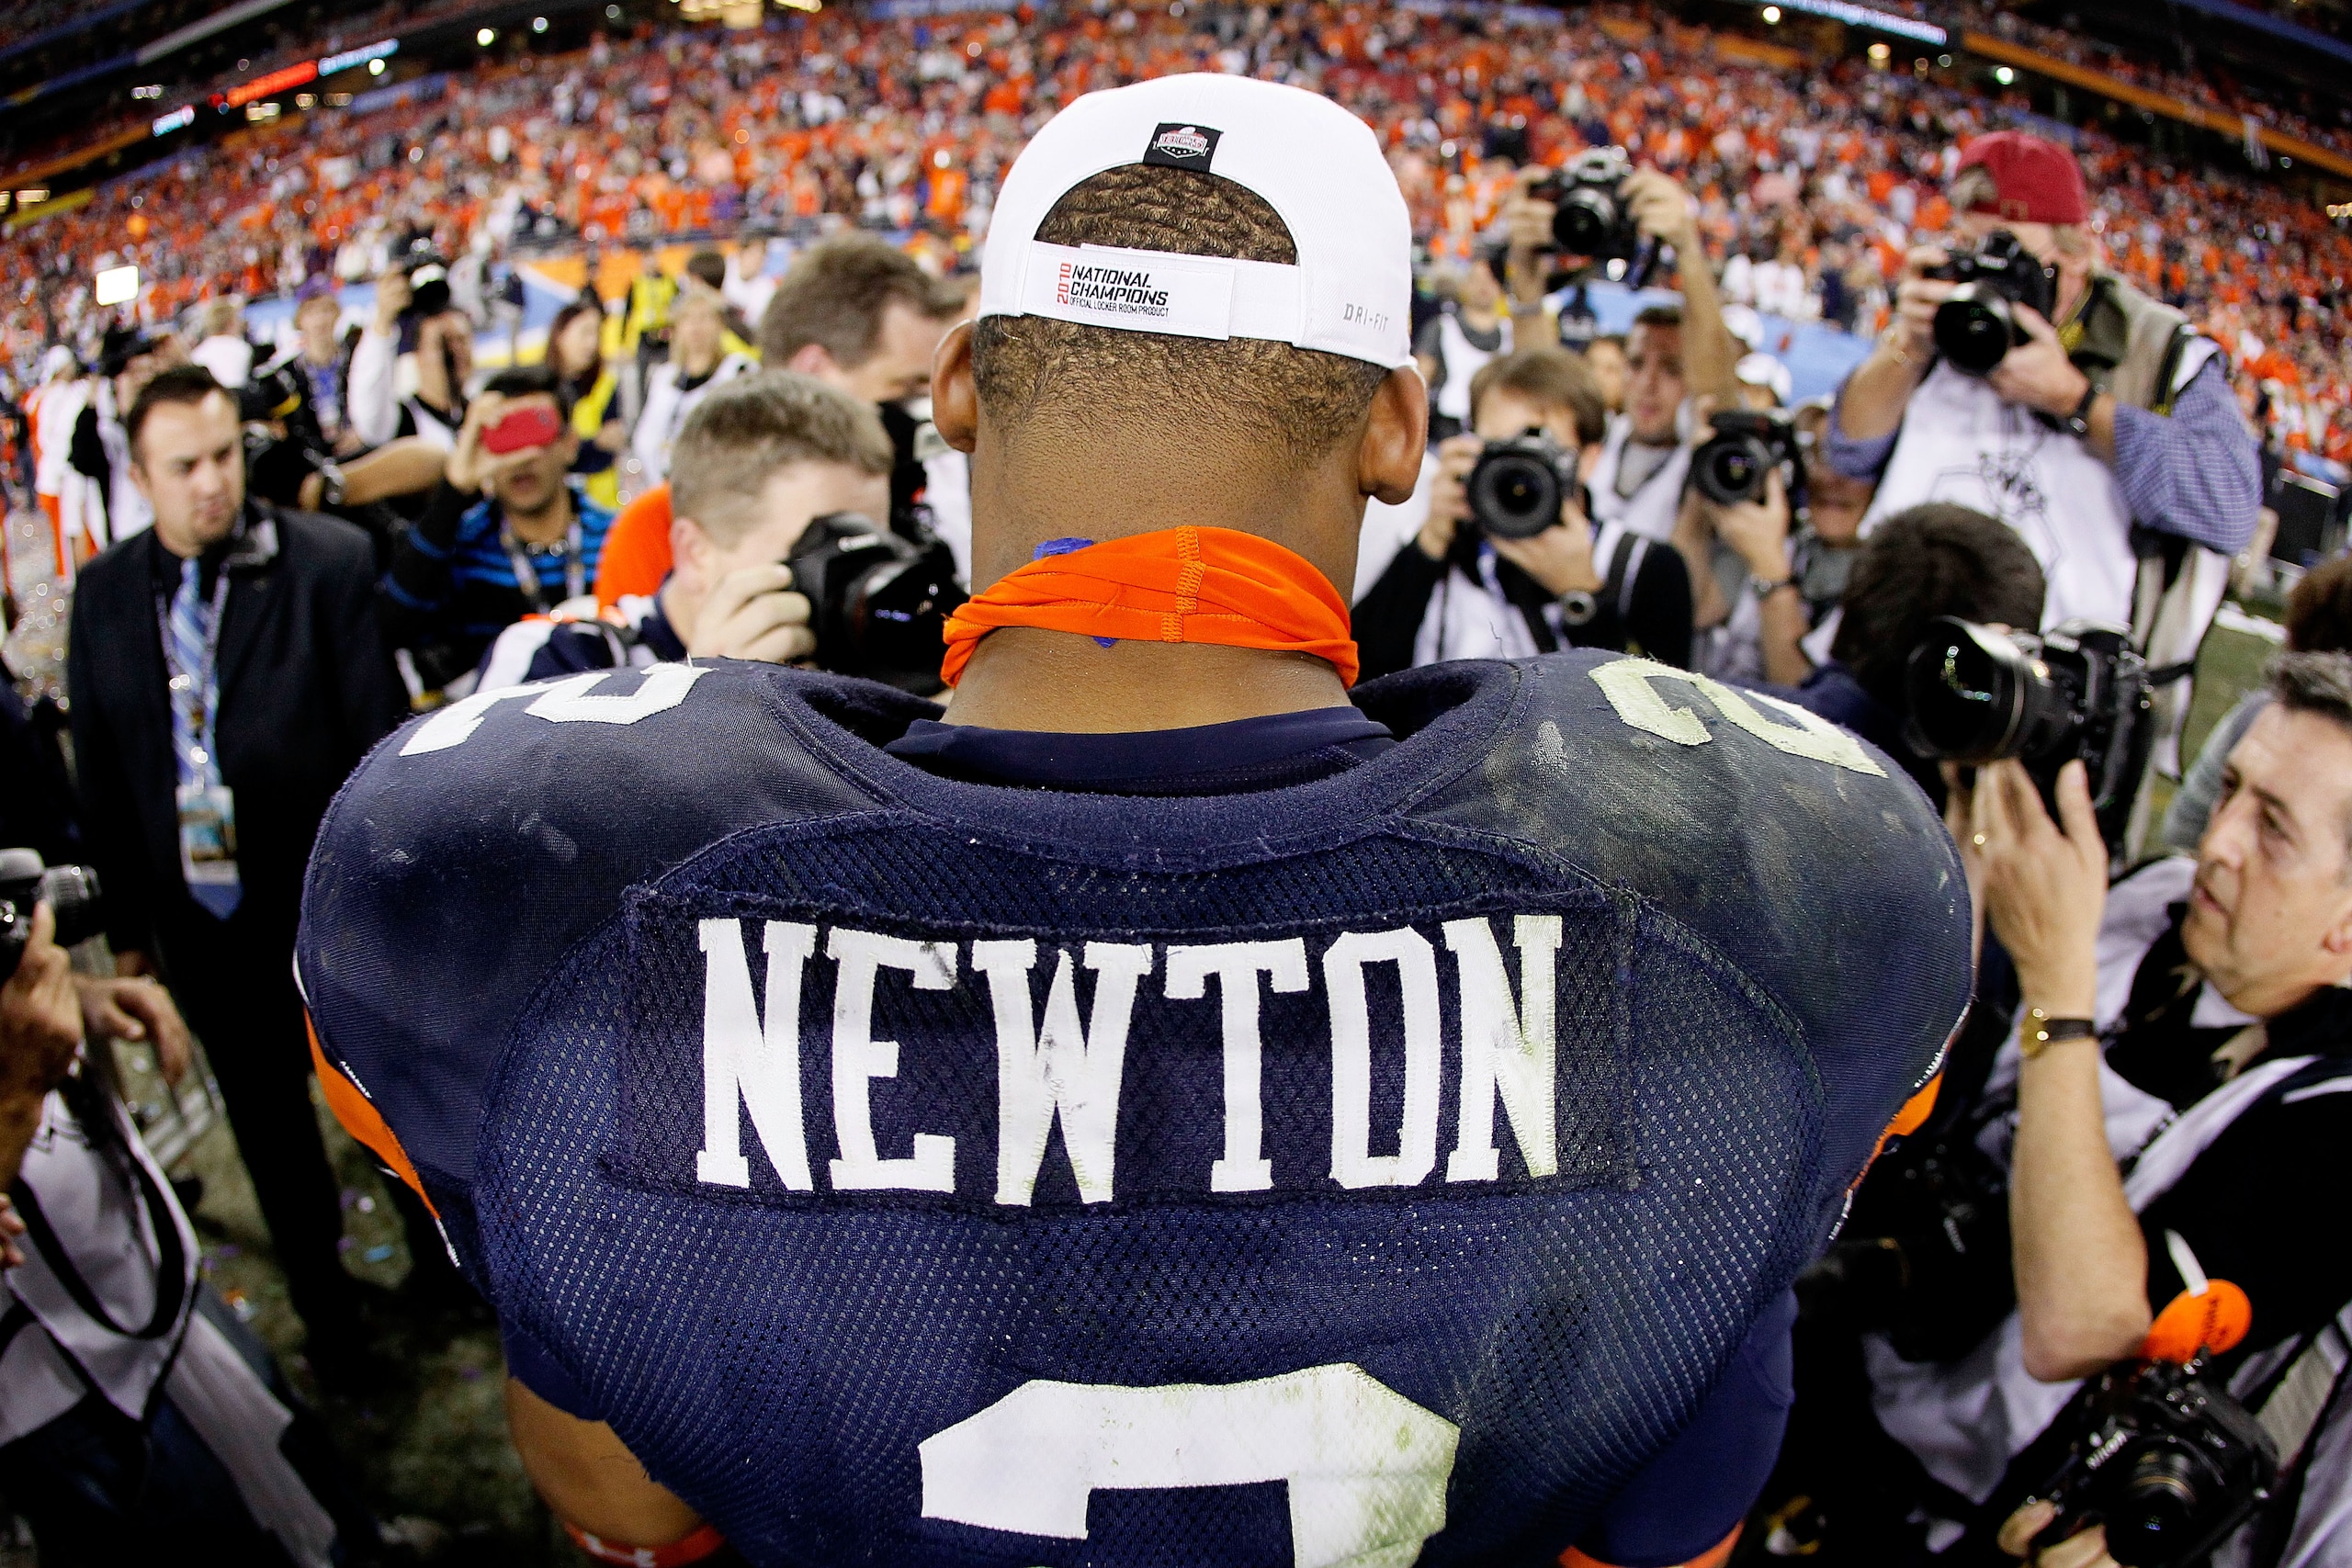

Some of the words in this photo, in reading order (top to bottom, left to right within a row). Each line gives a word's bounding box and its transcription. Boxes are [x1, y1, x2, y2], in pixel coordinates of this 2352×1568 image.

[1057, 263, 1071, 304] 2010
[1071, 265, 1152, 288] NATIONAL
[1070, 281, 1169, 306] CHAMPIONS
[1069, 297, 1092, 309] OFFICIAL
[1093, 301, 1117, 312] LOCKER
[1118, 304, 1137, 314] ROOM
[1138, 305, 1170, 318] PRODUCT
[1343, 303, 1388, 332] DRI-FIT
[696, 915, 1563, 1207] NEWTON
